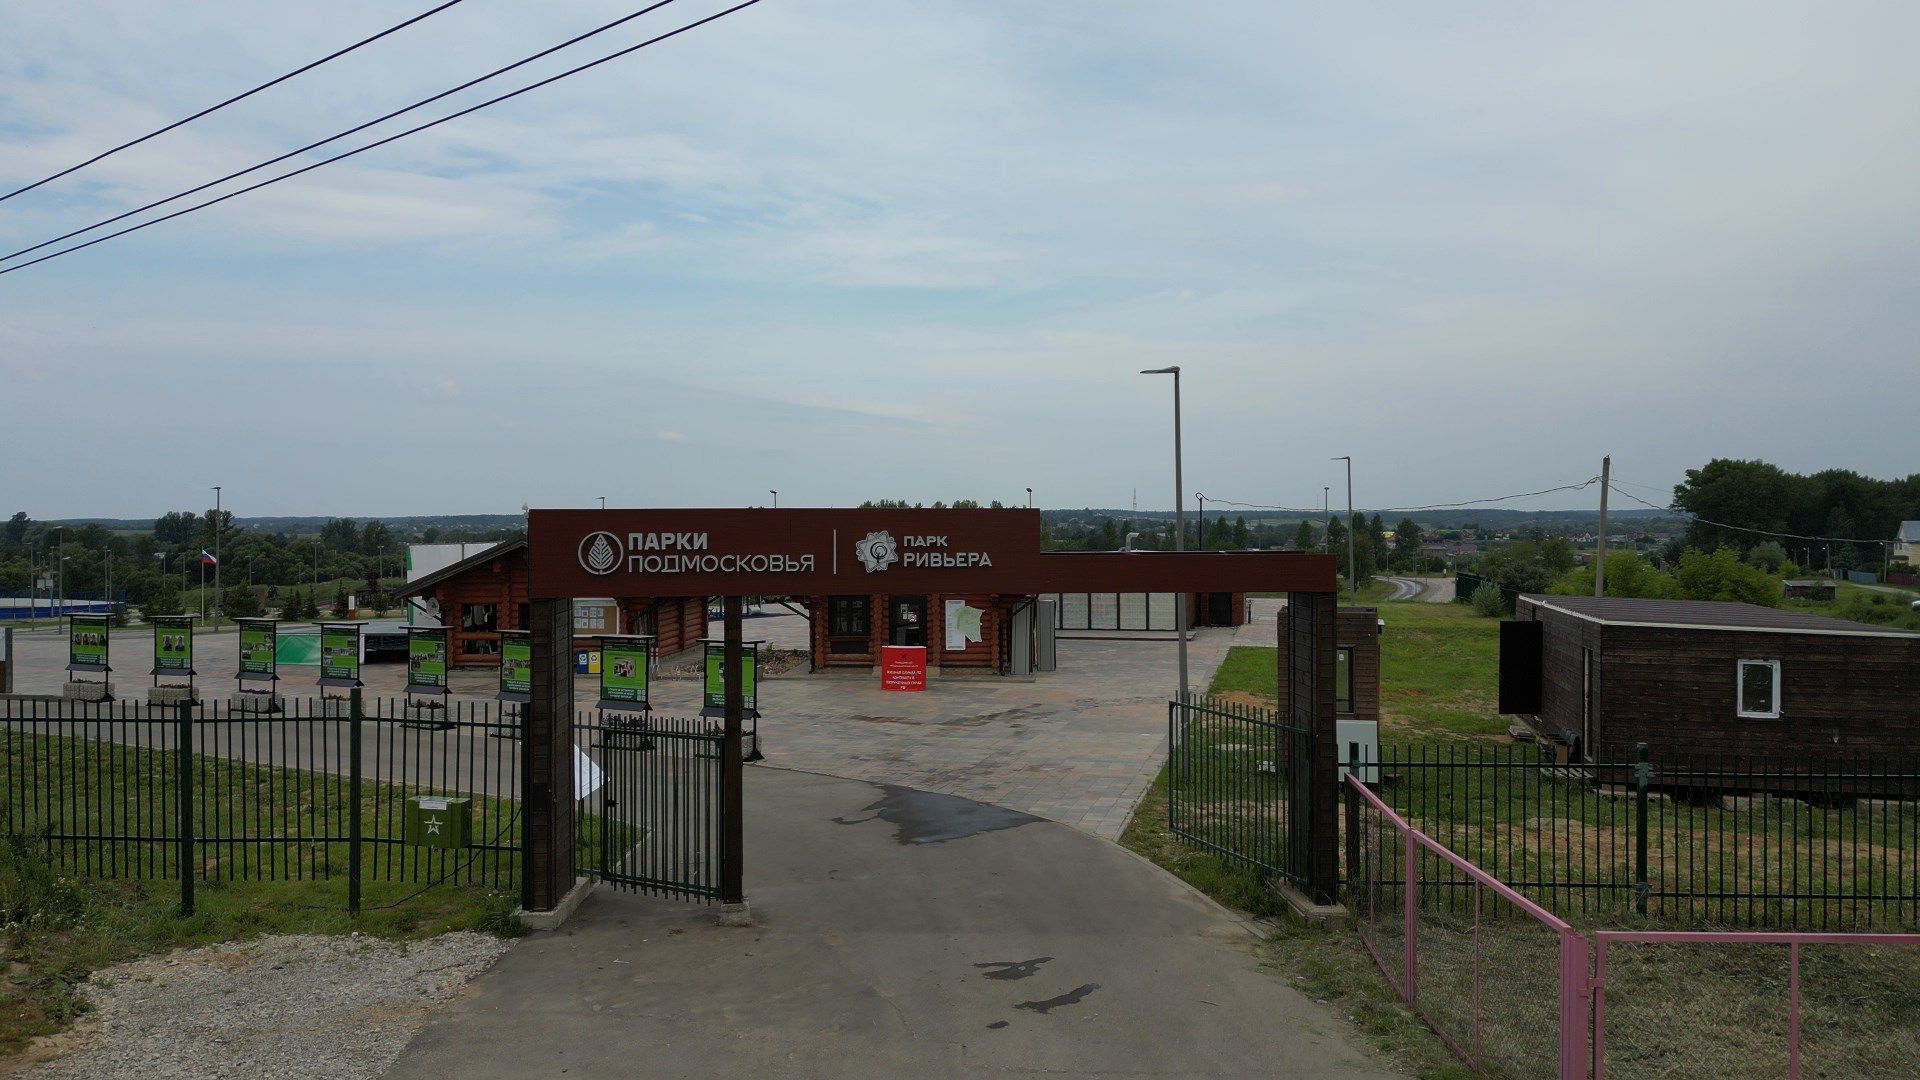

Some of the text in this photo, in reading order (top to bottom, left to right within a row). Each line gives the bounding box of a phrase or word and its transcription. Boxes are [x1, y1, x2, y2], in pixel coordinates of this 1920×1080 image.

[628, 533, 708, 551] ПАРКИ
[903, 536, 948, 547] ПАРК
[628, 554, 815, 573] ПОДМОСКОВЬЯ
[903, 552, 992, 567] РИВЬЕРА
